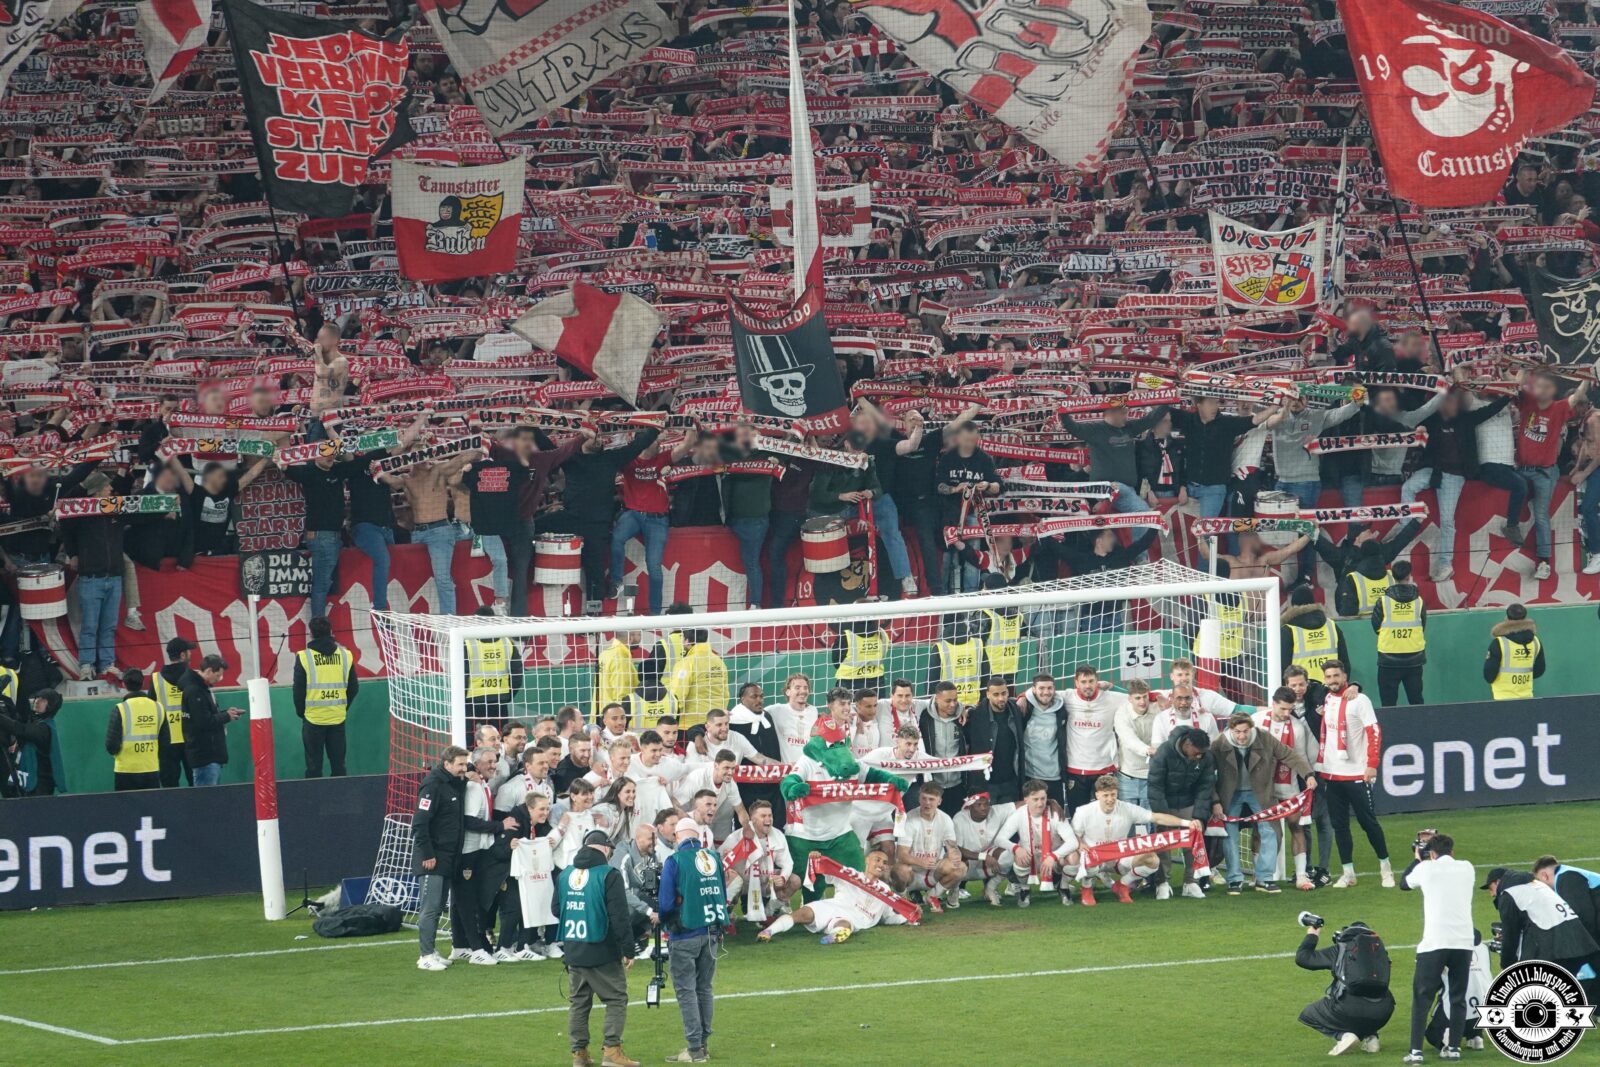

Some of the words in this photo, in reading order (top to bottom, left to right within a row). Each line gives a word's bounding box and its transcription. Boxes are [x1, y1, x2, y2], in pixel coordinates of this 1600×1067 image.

[1190, 2, 1209, 10] VfB
[1217, 6, 1301, 15] CONCORDIA
[1209, 31, 1295, 39] CONCORDIA
[267, 30, 409, 63] JEDER
[651, 48, 696, 64] BANDITEN
[474, 12, 663, 128] ULTRAS
[1359, 54, 1390, 80] 19
[892, 95, 939, 105] KURVE
[580, 111, 599, 119] VfB
[602, 111, 646, 121] Stuttgart
[158, 119, 205, 136] 1893
[579, 140, 655, 154] Stuttgart
[167, 160, 246, 172] STUTTGART
[418, 175, 500, 194] Cannstatter
[676, 182, 744, 193] STUTTGART
[425, 224, 486, 254] Buben
[1506, 228, 1524, 237] VfB
[1527, 227, 1576, 238] Stuttgart
[844, 304, 869, 314] Berlin
[838, 329, 869, 341] JEDER
[871, 331, 934, 344] VERBANNTE
[1452, 348, 1486, 364] ULT
[1504, 342, 1539, 356] RAS
[853, 381, 911, 392] COMMANDO
[1334, 371, 1437, 388] COMMANDO
[337, 405, 372, 418] ULT
[392, 401, 425, 414] RAS
[170, 413, 226, 426] COMMANDO
[242, 418, 297, 429] CANNSTATT
[479, 411, 519, 423] ULT
[541, 414, 583, 429] RAS
[753, 414, 793, 429] RAS
[161, 437, 195, 457] CC97
[1318, 436, 1356, 451] ULT
[1377, 433, 1416, 448] RAS
[280, 443, 317, 463] CC97
[379, 435, 482, 472] COMMANDO
[763, 437, 793, 454] ULT
[823, 450, 861, 467] RAS
[983, 443, 1046, 458] CANNSTATTER
[1048, 449, 1079, 461] KURVE
[59, 496, 98, 516] CC97
[241, 502, 306, 518] KEHR
[1041, 499, 1081, 512] RAS
[1316, 509, 1352, 522] ULT
[1371, 505, 1412, 518] RAS
[236, 519, 305, 536] STARK
[1042, 517, 1092, 531] Commando
[1108, 514, 1158, 526] Cannstatt
[240, 534, 301, 551] ZURÜ
[269, 554, 287, 568] DU
[269, 584, 292, 596] BEI
[1371, 586, 1388, 595] SDS
[1394, 601, 1412, 610] SDS
[1308, 630, 1325, 640] SDS
[1391, 628, 1413, 639] 1827
[314, 651, 342, 666] SECURITY
[483, 650, 501, 660] SDS
[1125, 645, 1156, 668] 35
[1514, 647, 1532, 657] SDS
[481, 677, 503, 688] 2031
[1512, 674, 1531, 686] 0804
[321, 689, 340, 700] 3445
[136, 715, 155, 723] SDS
[1073, 719, 1104, 728] FINALE
[134, 741, 155, 753] 0873
[906, 754, 975, 769] STUTTGART
[1382, 722, 1566, 797] enet
[822, 783, 889, 798] FINALE
[1117, 829, 1192, 853] FINALE
[566, 900, 585, 911] DFB.DE
[703, 904, 725, 923] 55
[565, 920, 587, 940] 20
